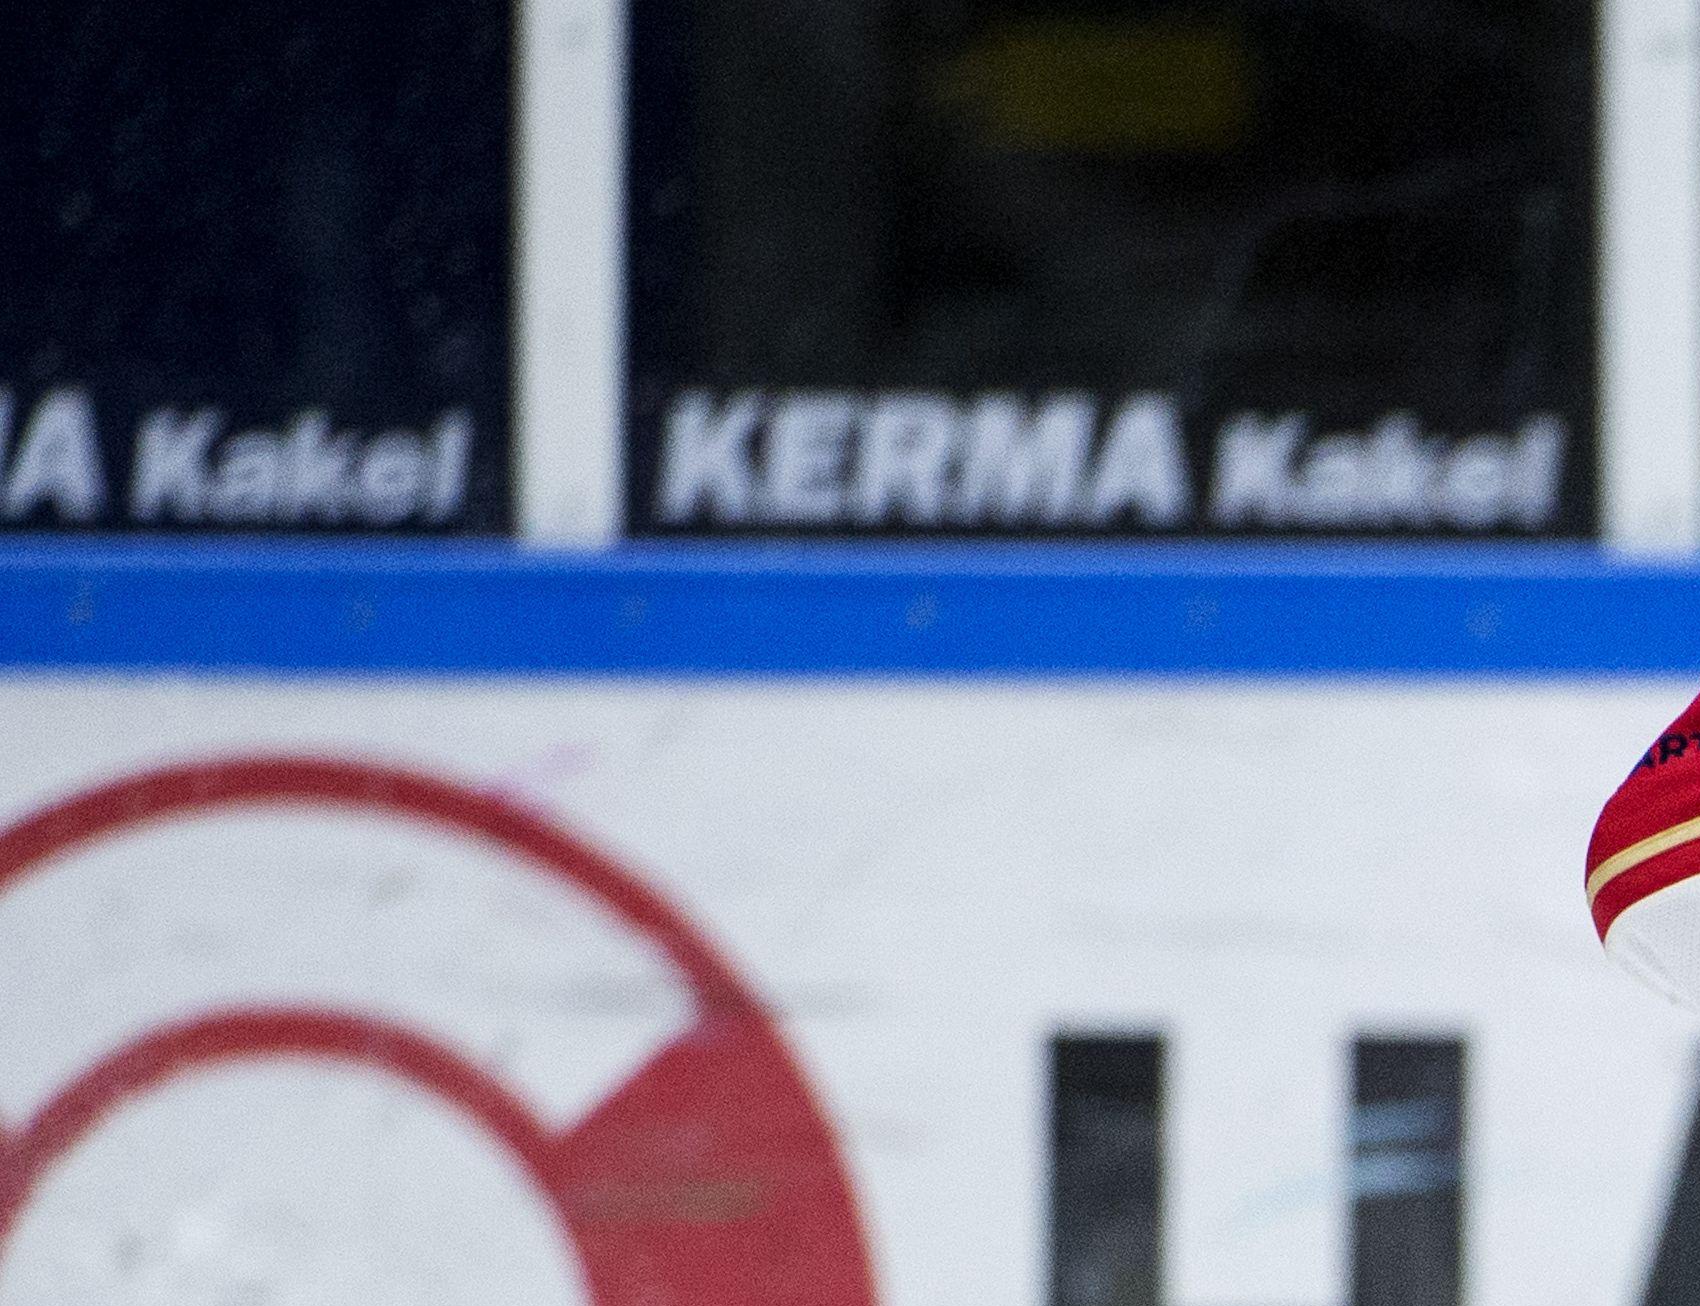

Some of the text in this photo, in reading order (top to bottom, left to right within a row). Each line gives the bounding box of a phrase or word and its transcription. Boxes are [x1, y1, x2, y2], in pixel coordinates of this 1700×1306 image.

[130, 405, 472, 522] Kakel
[658, 390, 1568, 528] KERMA Kakel
